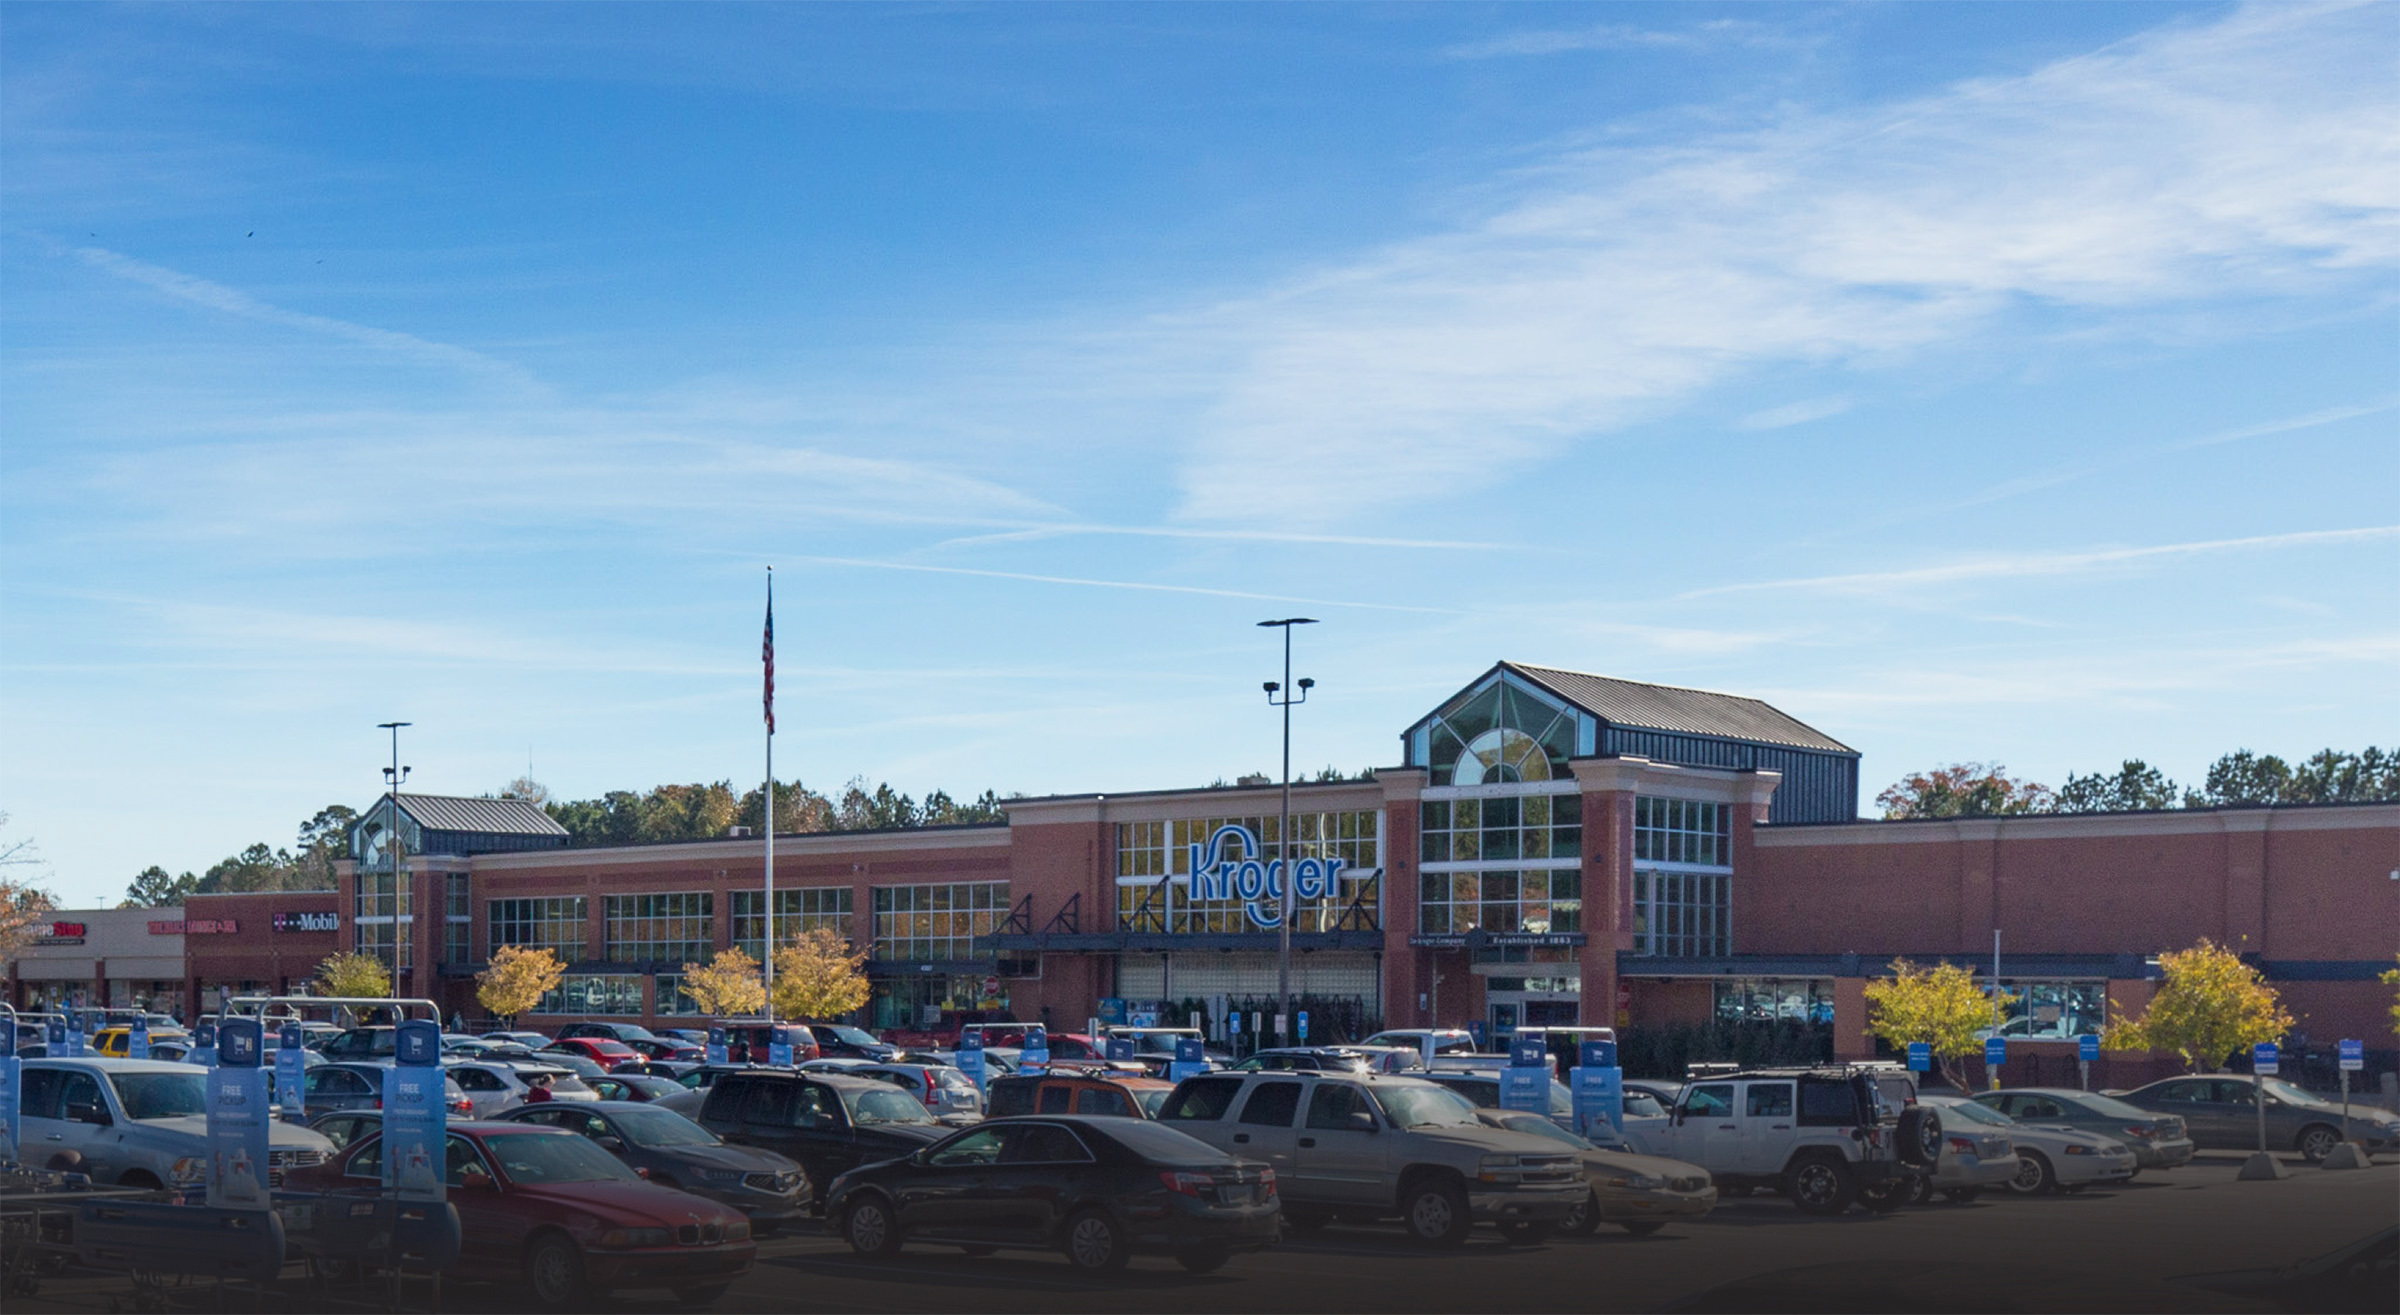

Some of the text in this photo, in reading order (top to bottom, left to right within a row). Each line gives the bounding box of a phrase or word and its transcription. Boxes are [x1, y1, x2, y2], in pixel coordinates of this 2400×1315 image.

[1189, 824, 1346, 928] Kroger
[1493, 936, 1571, 944] Established 1883
[222, 1085, 242, 1096] FREE
[399, 1083, 420, 1094] FREE
[216, 1096, 246, 1106] PICKUP
[395, 1093, 424, 1103] PICKUP
